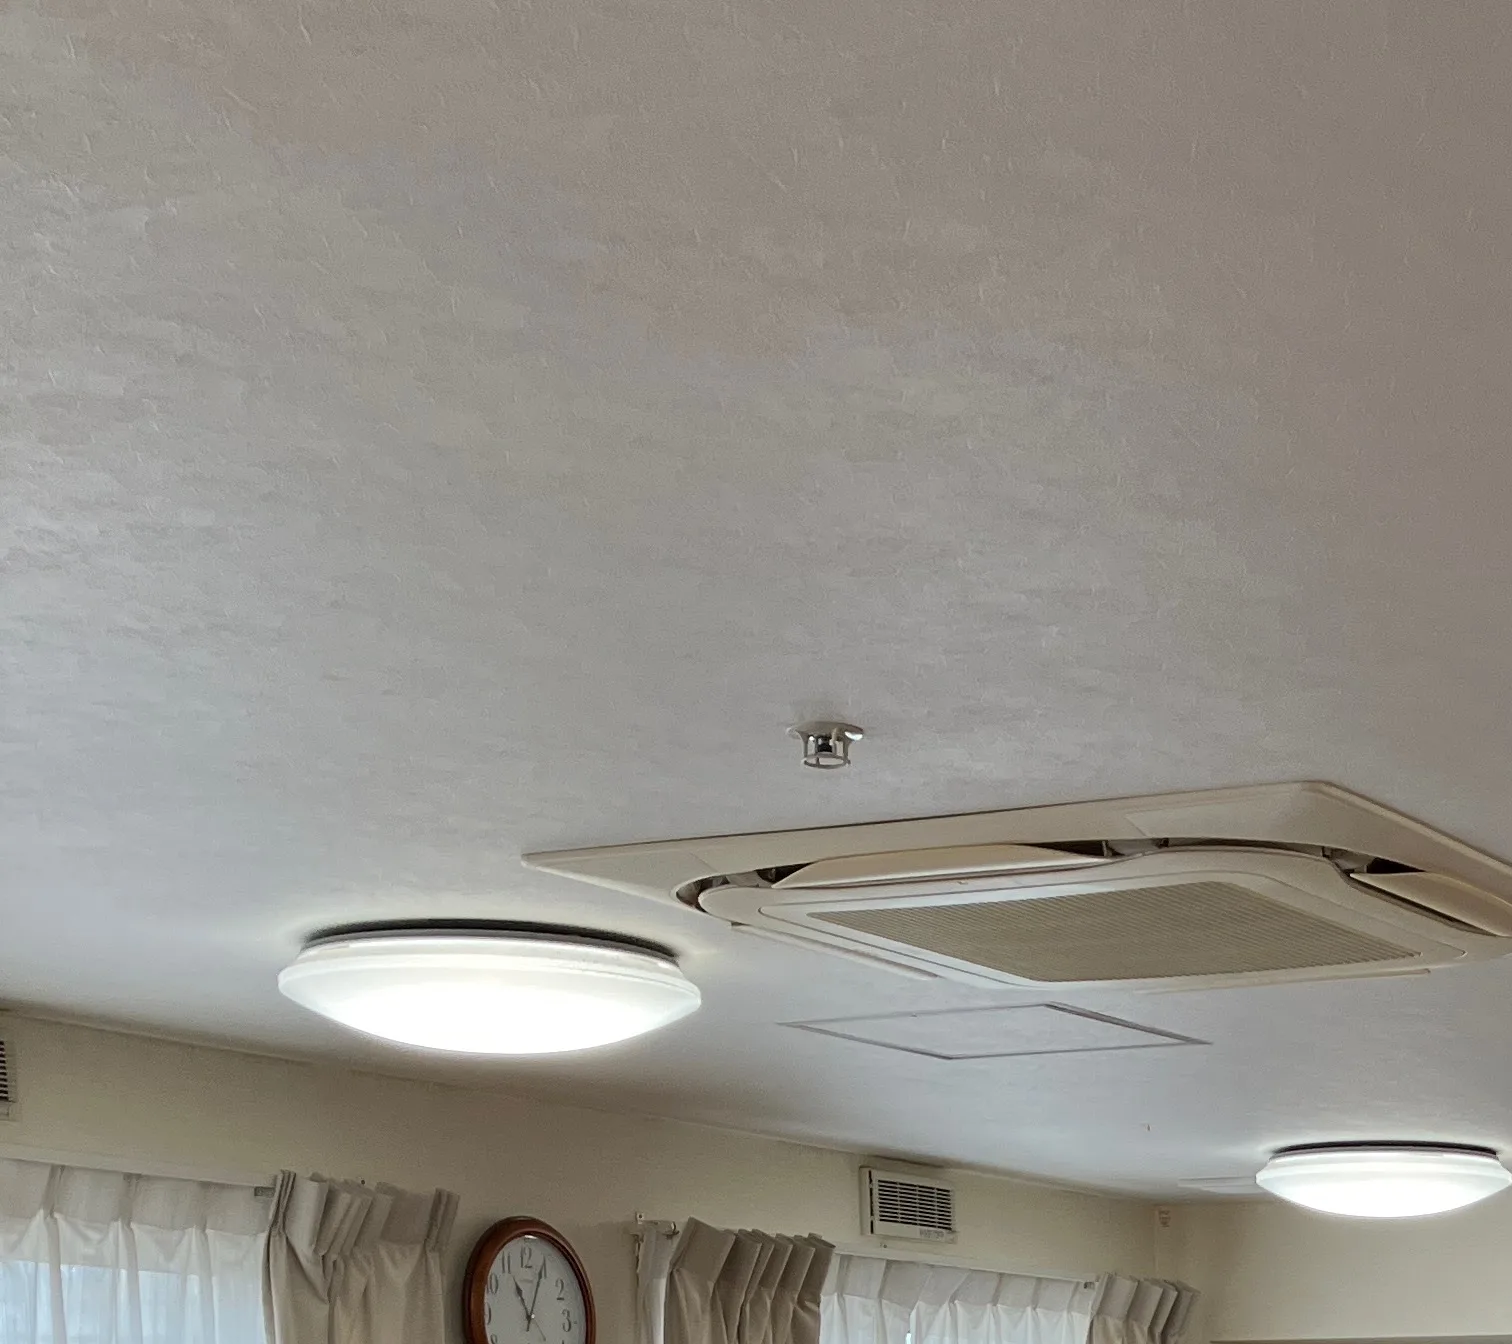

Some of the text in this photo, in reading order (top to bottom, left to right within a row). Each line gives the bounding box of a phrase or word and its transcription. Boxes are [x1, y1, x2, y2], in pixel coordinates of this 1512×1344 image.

[501, 1250, 511, 1274] 11
[520, 1246, 532, 1269] 12
[555, 1278, 565, 1301] 2
[562, 1309, 571, 1332] 3
